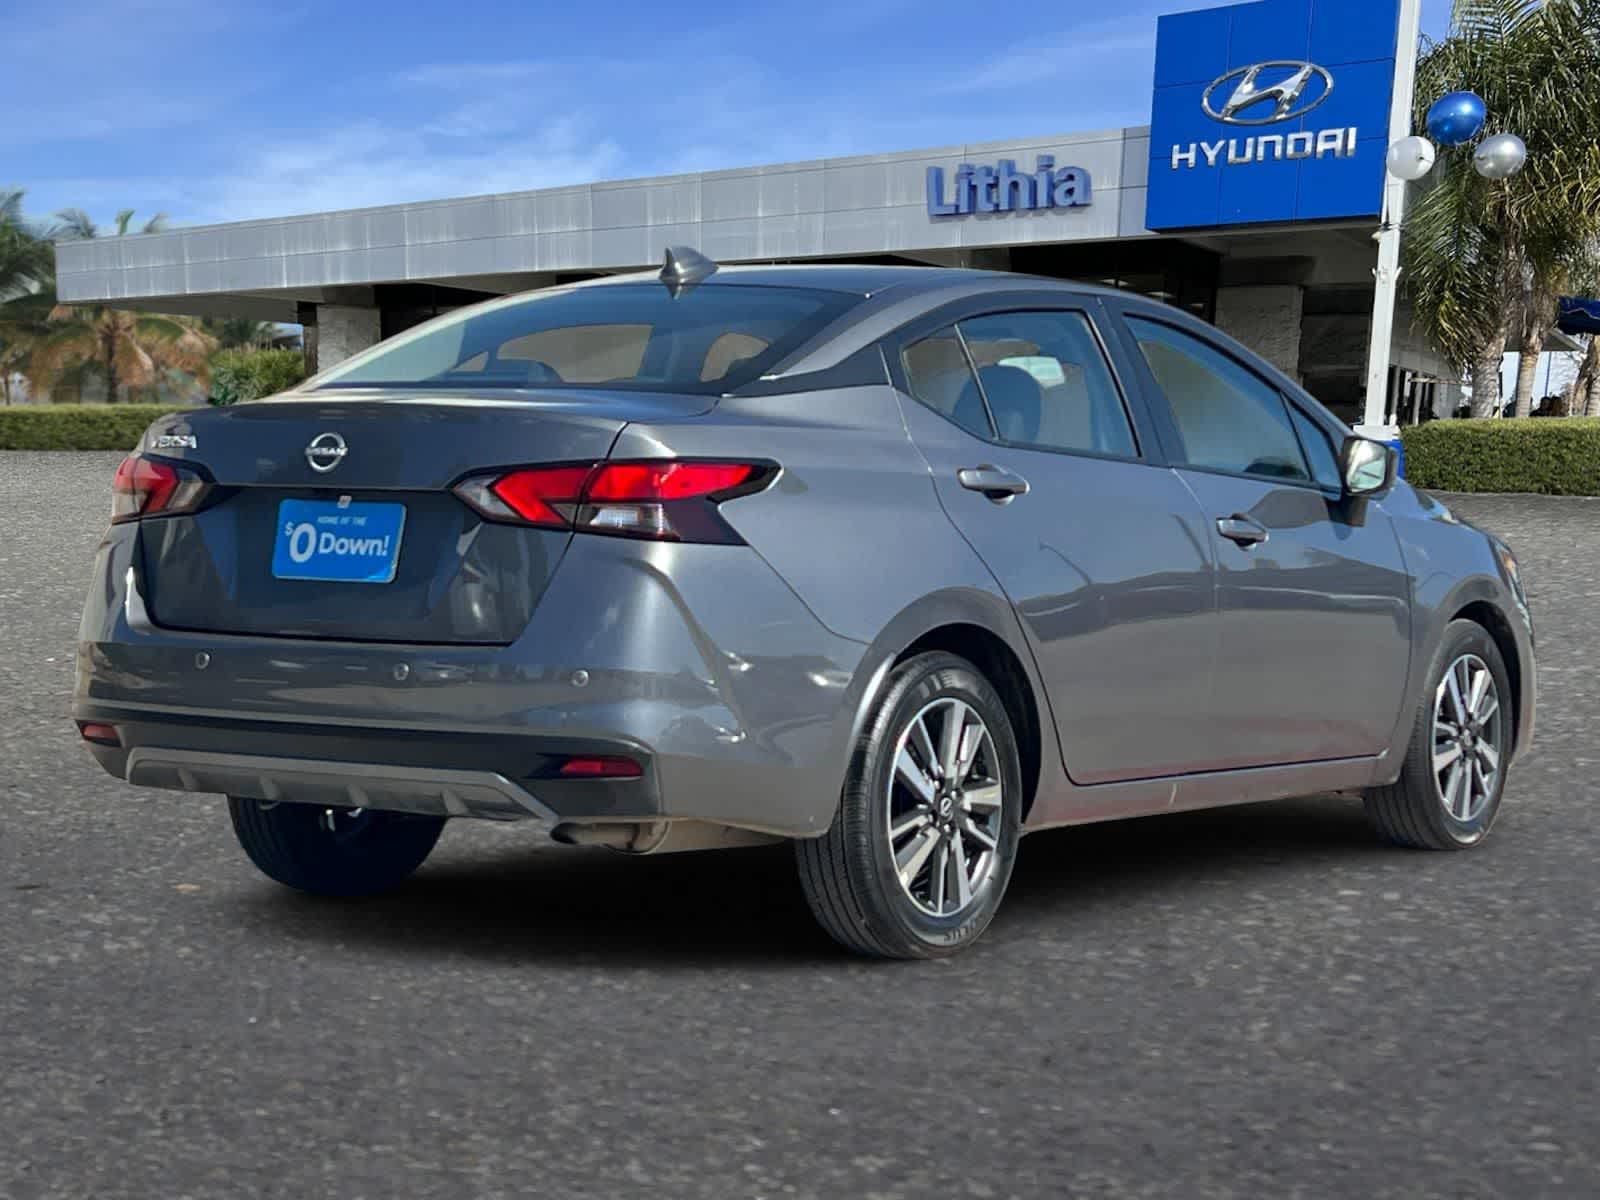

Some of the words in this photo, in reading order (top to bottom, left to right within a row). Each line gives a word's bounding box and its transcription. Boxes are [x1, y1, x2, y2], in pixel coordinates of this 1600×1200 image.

[1171, 127, 1358, 169] HYUNDAI
[926, 155, 1092, 216] Lithia
[306, 447, 348, 456] NISSAN
[319, 532, 390, 557] Down!
